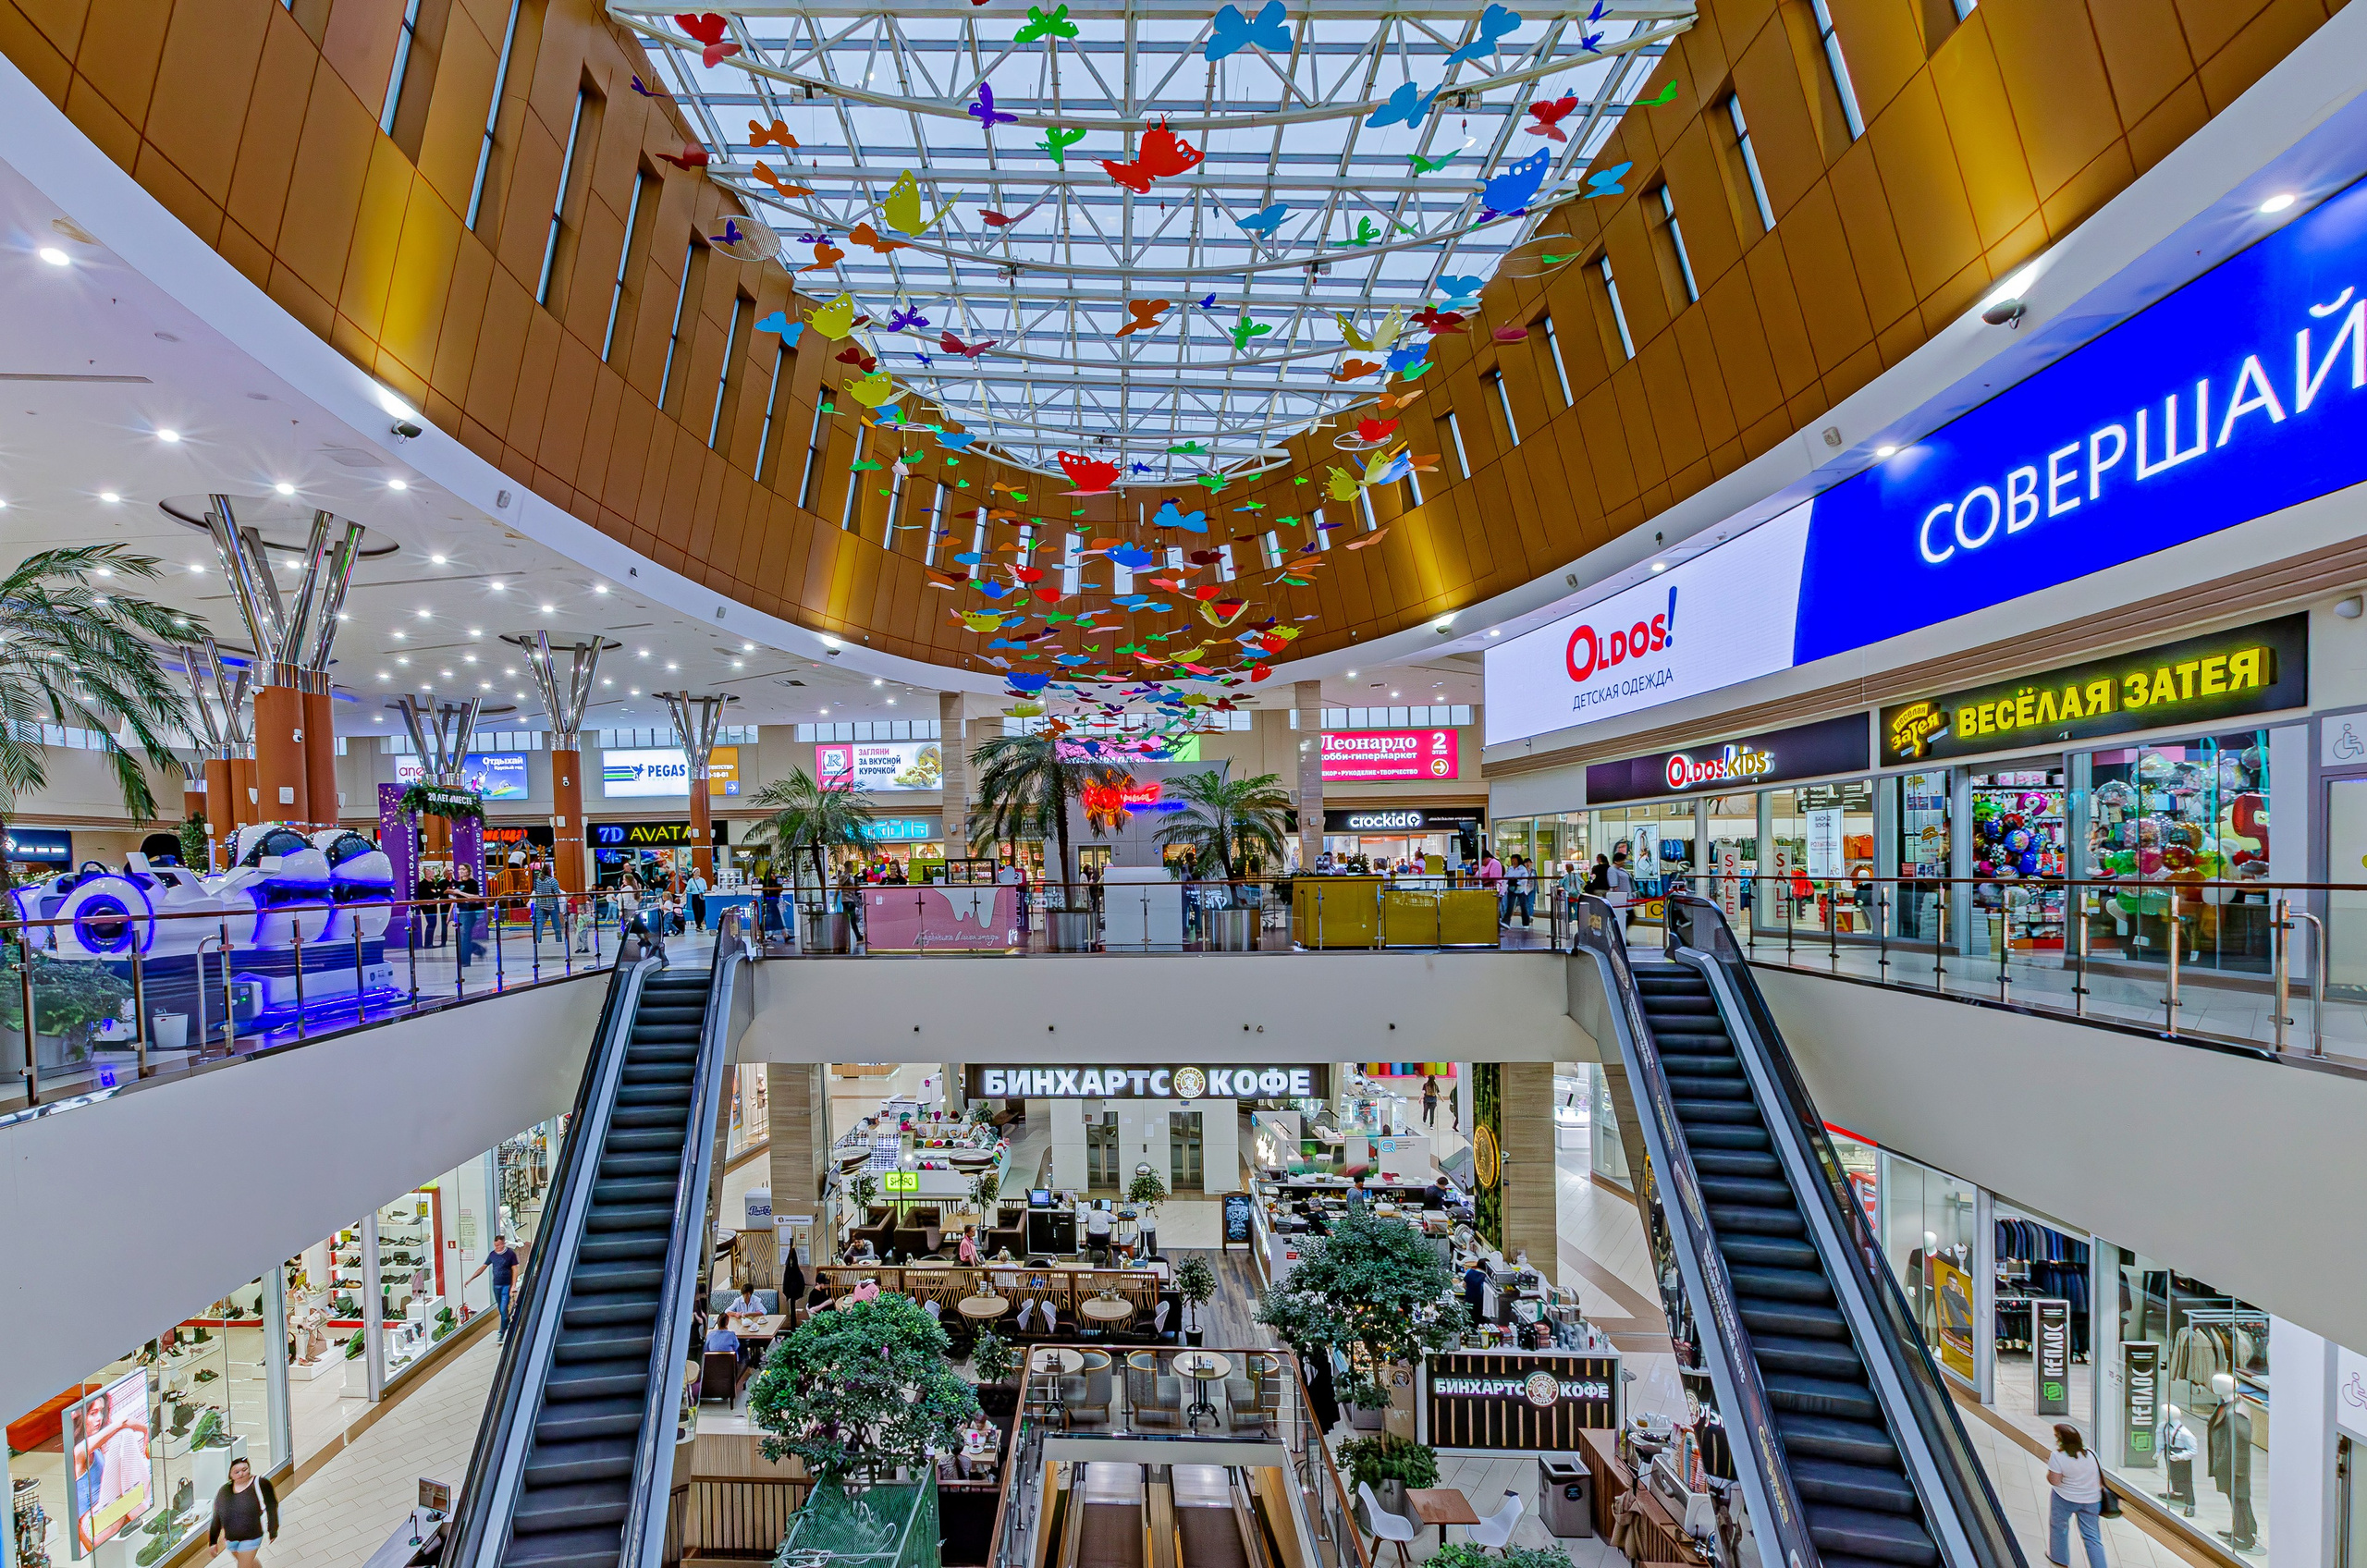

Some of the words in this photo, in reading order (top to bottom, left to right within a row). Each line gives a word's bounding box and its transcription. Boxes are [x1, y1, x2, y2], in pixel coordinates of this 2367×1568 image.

[1919, 286, 2367, 564] СОВЕРШАЙ
[1565, 585, 1678, 682] OLDOS!
[1573, 683, 1619, 712] ДЕТСКАЯ
[1621, 668, 1674, 696] ОДЕЖДА
[1958, 679, 2113, 738] ВЕСЁЛАЯ
[2124, 646, 2263, 709] ЗАТЕЯ
[1321, 734, 1417, 753] Леонардо
[1432, 732, 1446, 750] 2
[483, 756, 523, 766] Отдыхай
[858, 748, 889, 756] ЗАГЛЯНИ
[869, 754, 901, 766] ВКУСНОЙ
[399, 766, 425, 777] ane
[647, 764, 686, 778] PEGAS
[858, 765, 896, 775] КУРОЧКОЙ
[437, 793, 449, 802] ЛЕТ
[1349, 813, 1406, 828] crockid
[598, 827, 624, 842] 7D
[630, 826, 692, 842] AVATA
[1723, 853, 1736, 915] SALE
[1774, 852, 1788, 919] SALE
[984, 1069, 1171, 1096] БИНХАРТС
[1208, 1068, 1311, 1096] КОФЕ
[1435, 1380, 1525, 1397] БИНХАРТС
[1560, 1384, 1610, 1399] КОФЕ
